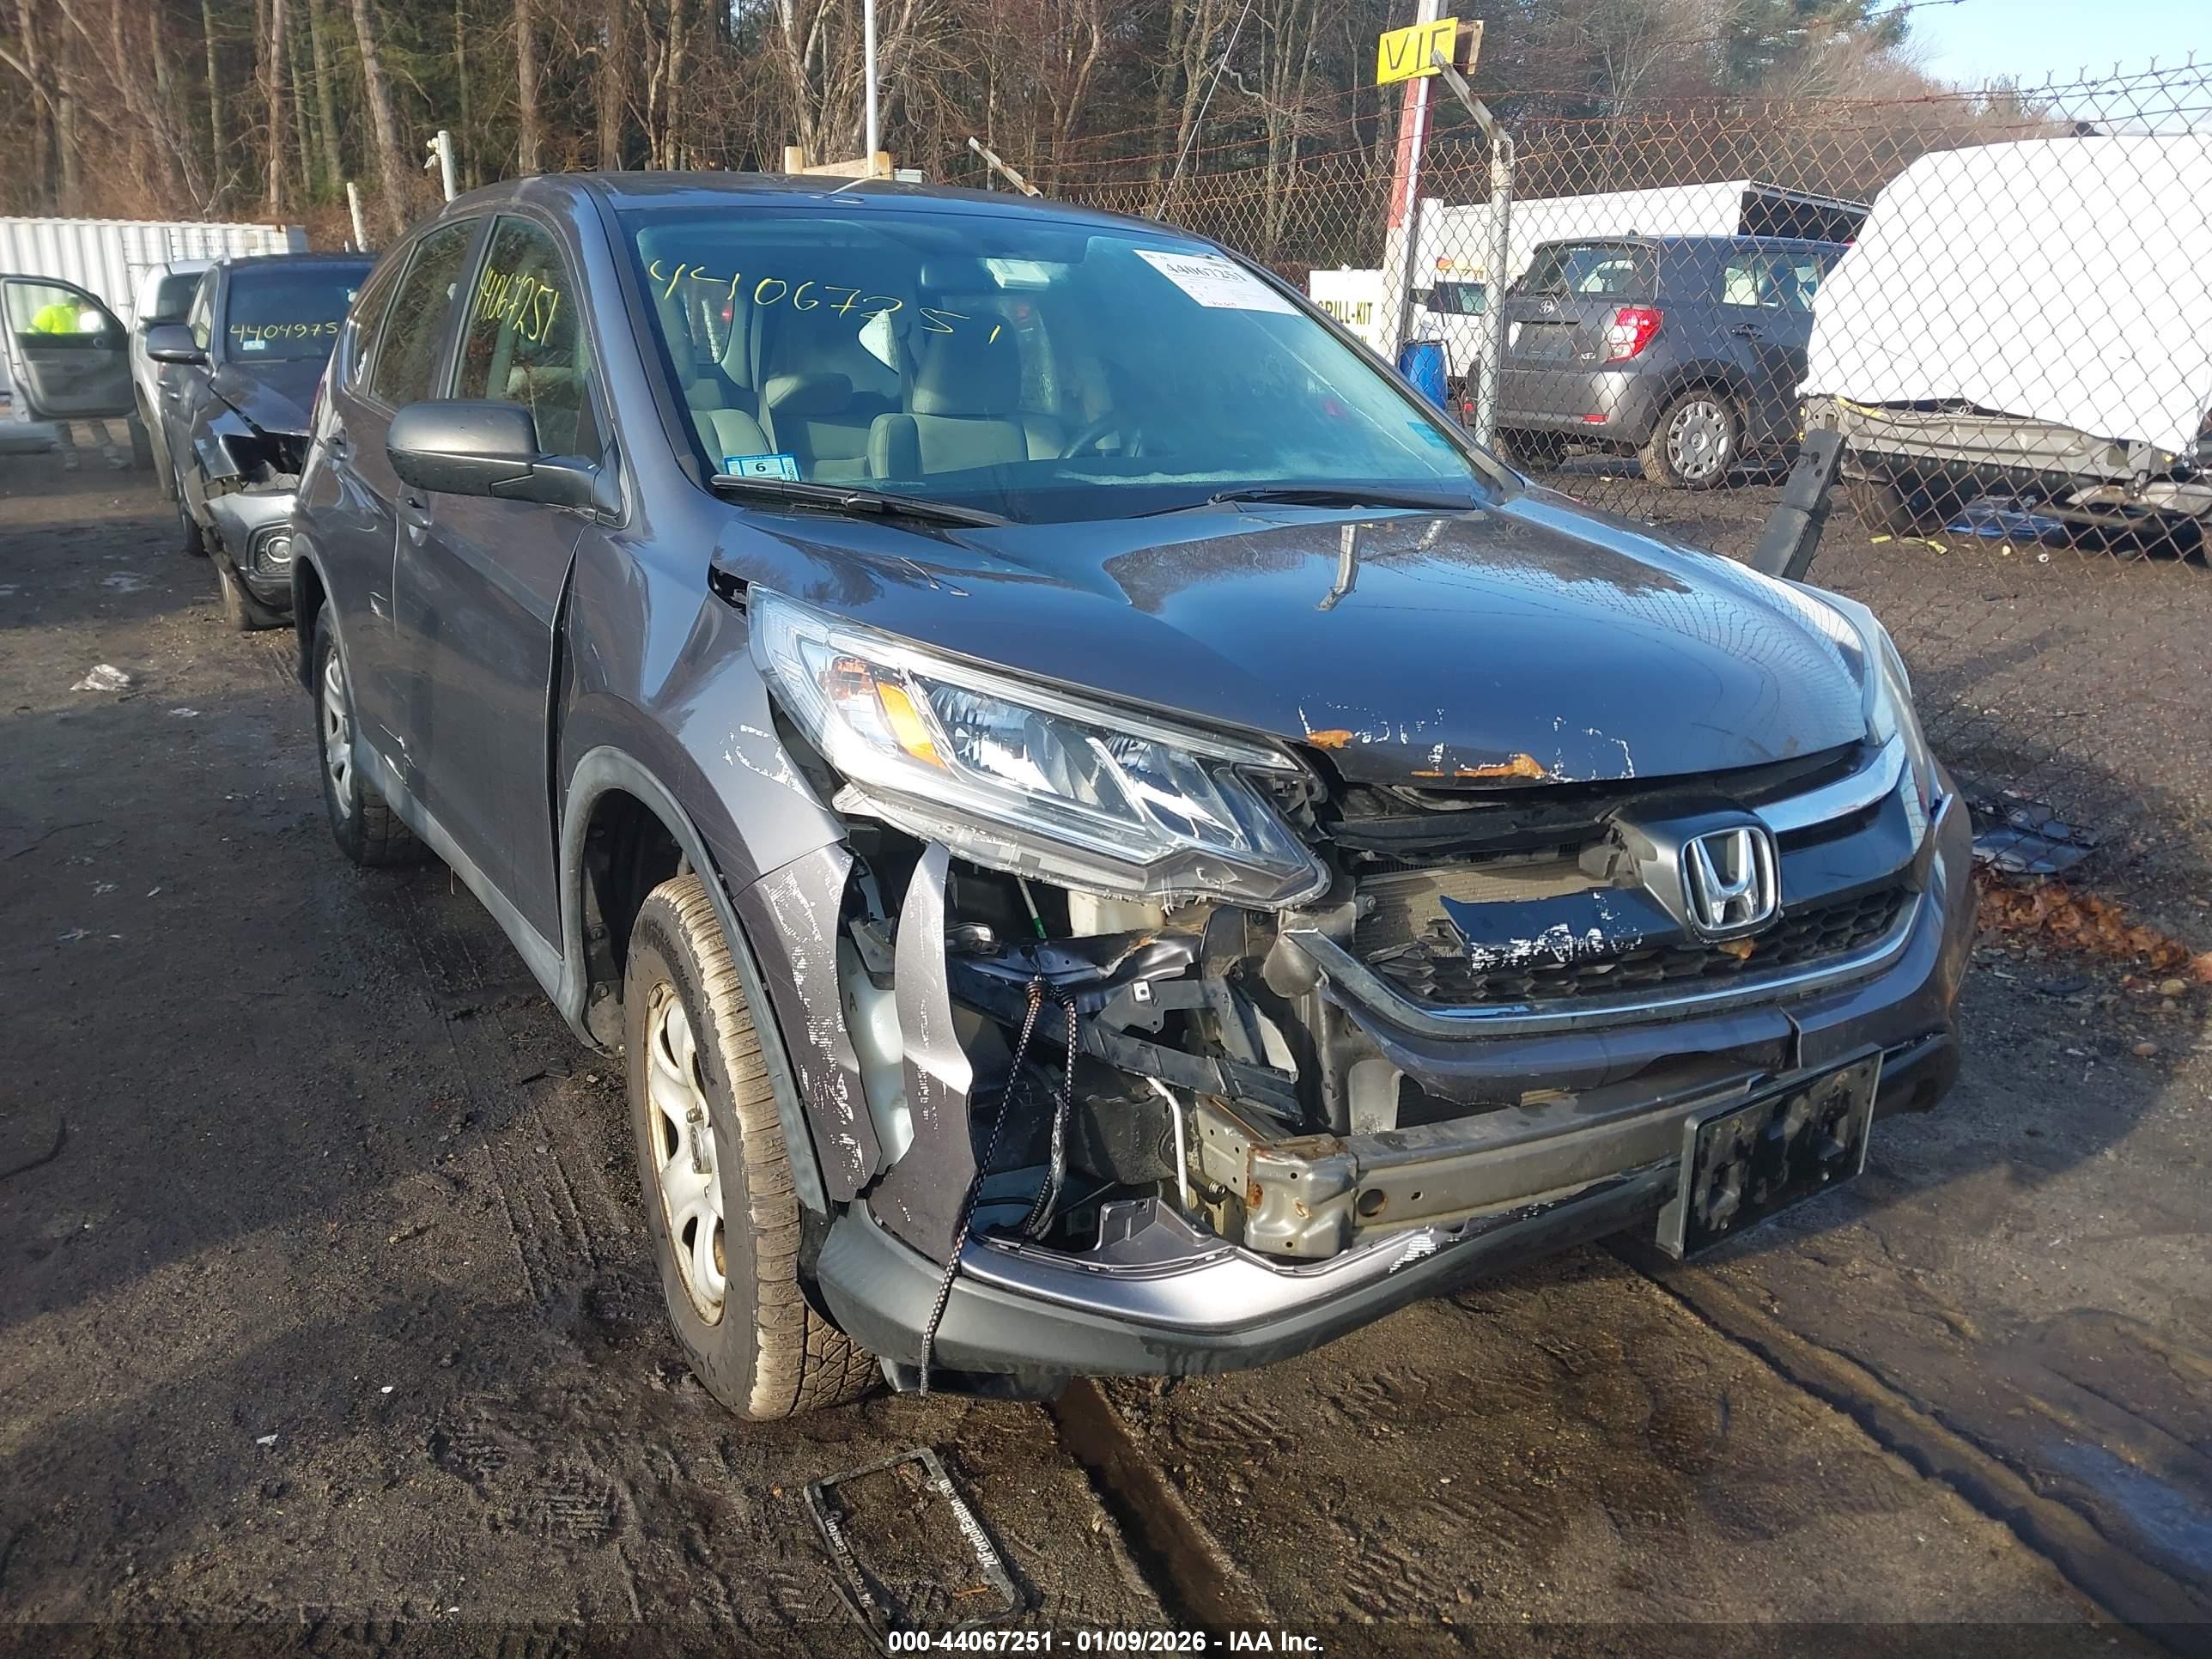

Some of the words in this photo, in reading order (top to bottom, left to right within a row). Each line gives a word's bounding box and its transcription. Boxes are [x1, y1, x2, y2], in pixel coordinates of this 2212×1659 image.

[1165, 262, 1249, 283] 44067251
[229, 322, 338, 343] 4404975
[756, 462, 766, 472] 6
